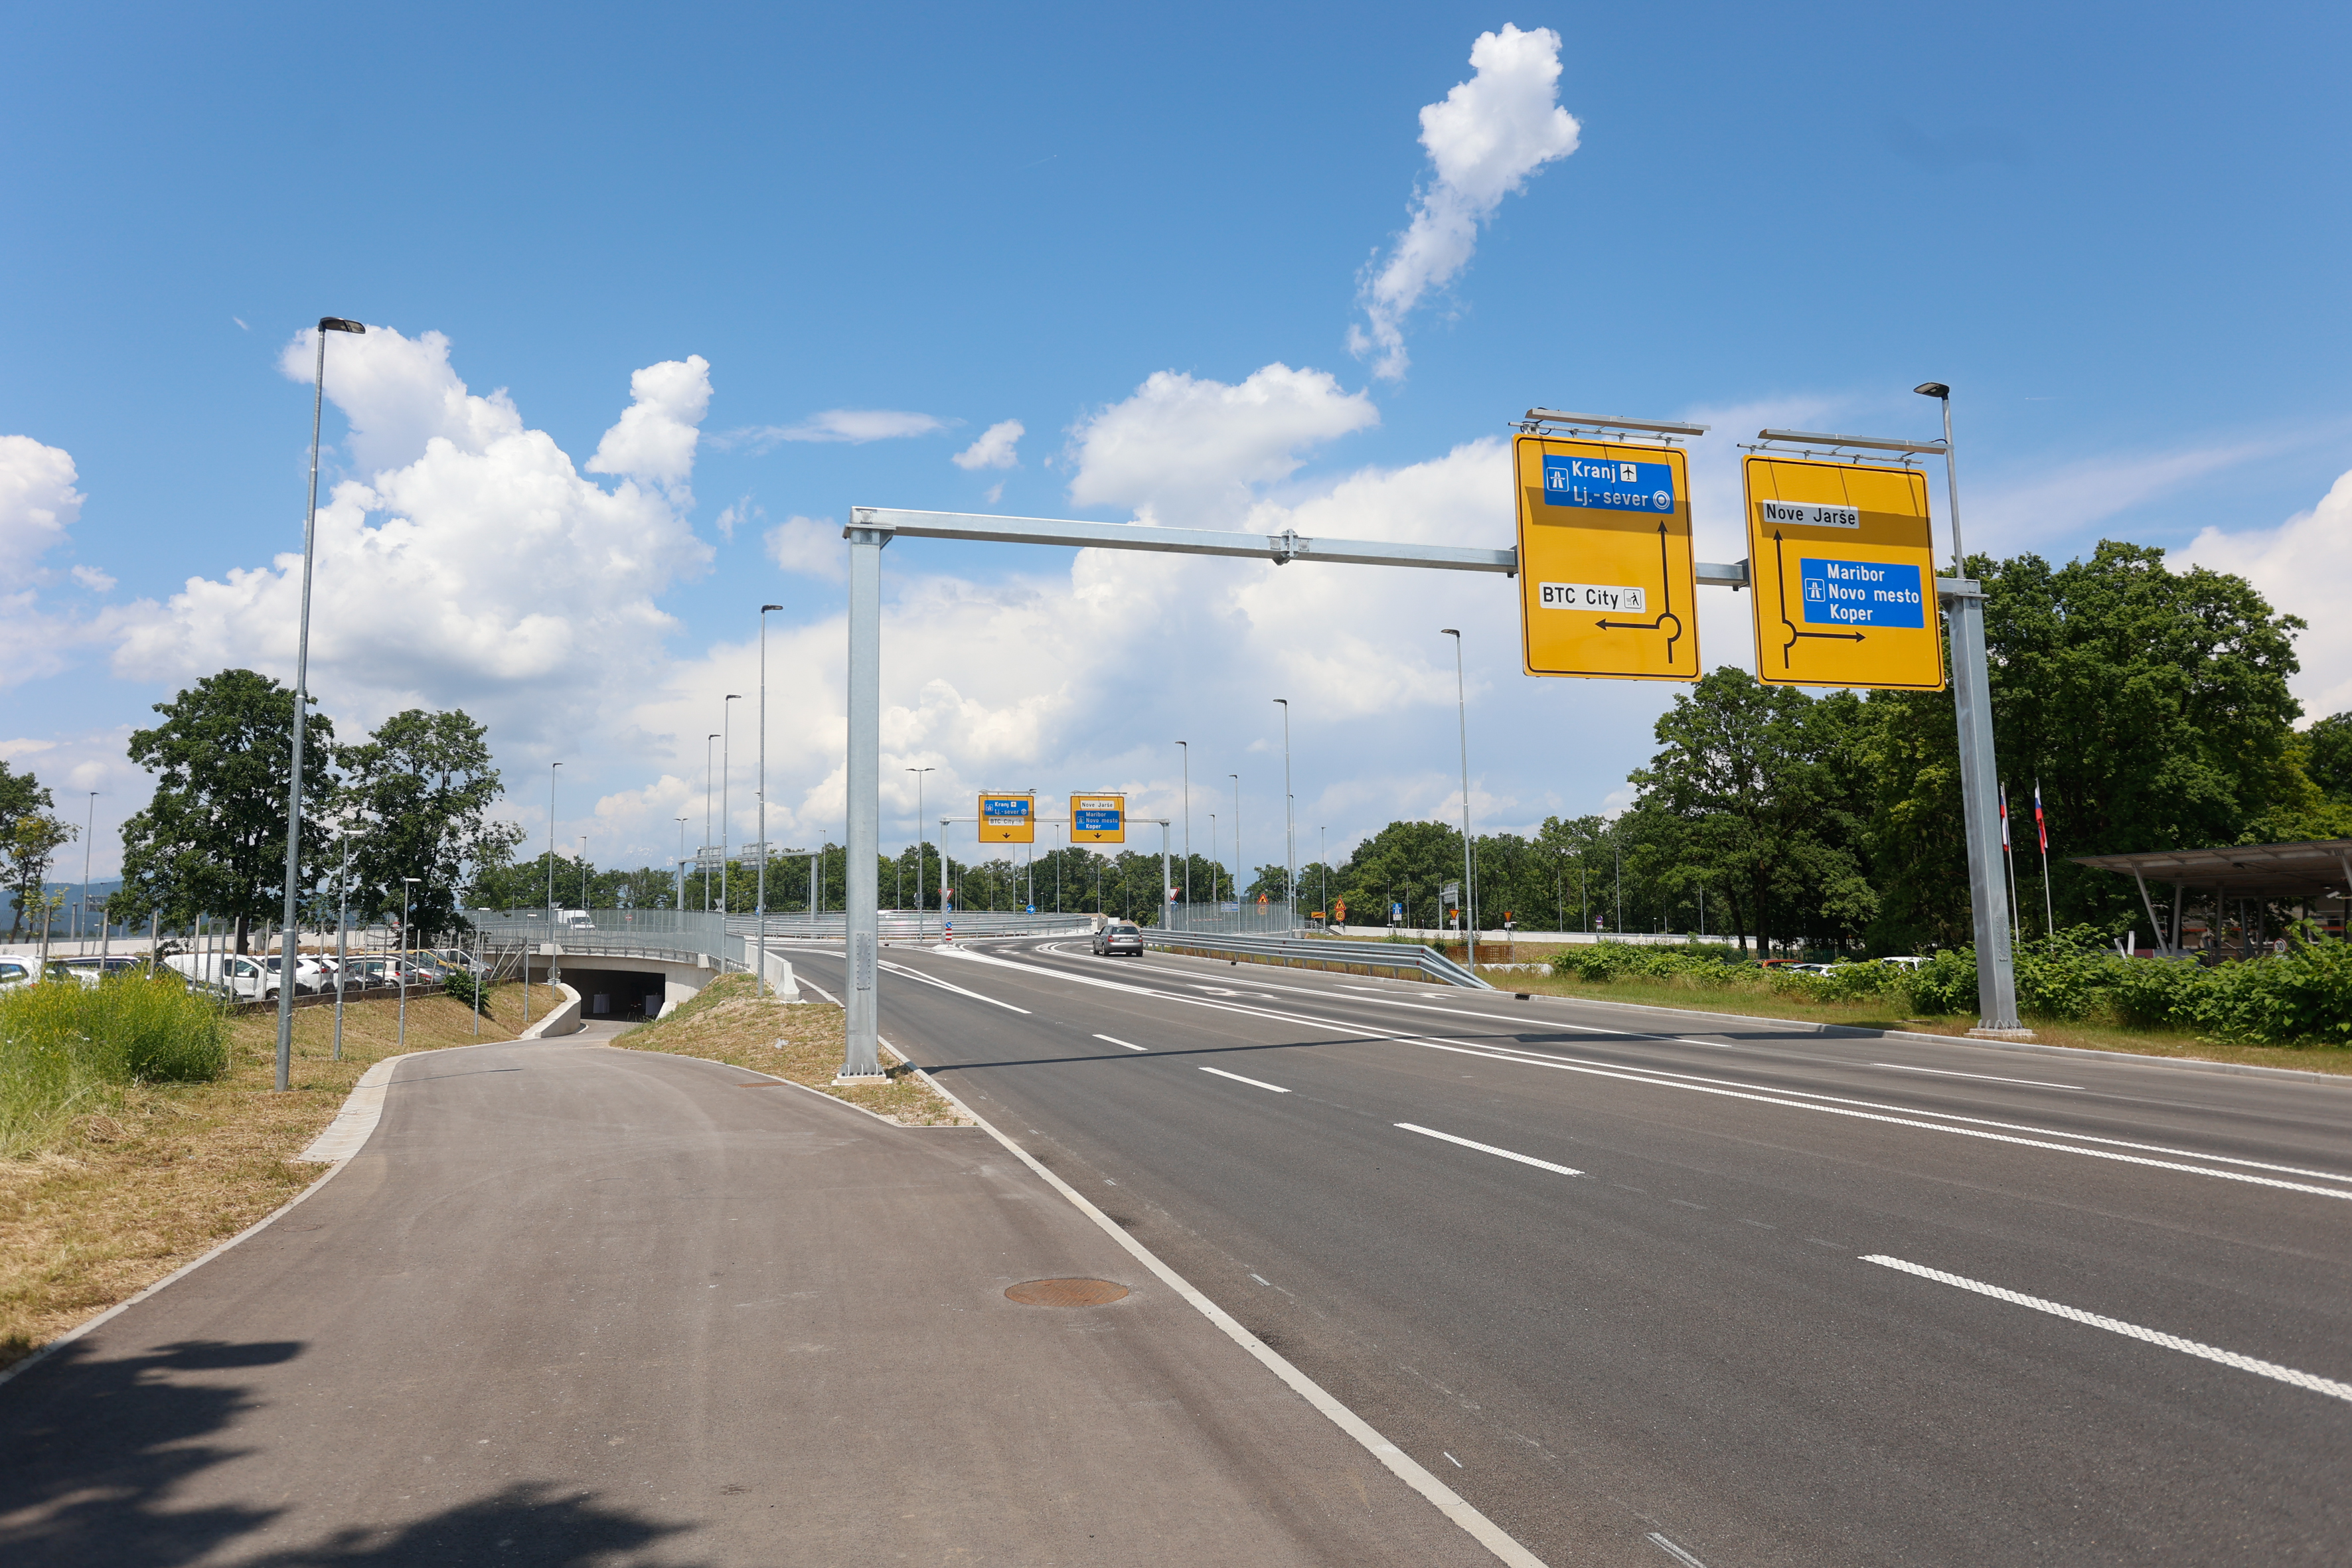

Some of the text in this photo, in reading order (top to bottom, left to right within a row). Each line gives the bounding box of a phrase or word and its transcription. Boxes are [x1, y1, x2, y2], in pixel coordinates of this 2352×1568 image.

[1572, 461, 1616, 483] Kranj
[1574, 486, 1649, 507] Lj.-sever
[1766, 504, 1856, 526] Nove Jarše
[1827, 563, 1885, 582] Maribor
[1543, 586, 1619, 609] BTC City
[1828, 584, 1920, 604] Novo mesto
[1830, 603, 1873, 623] Koper
